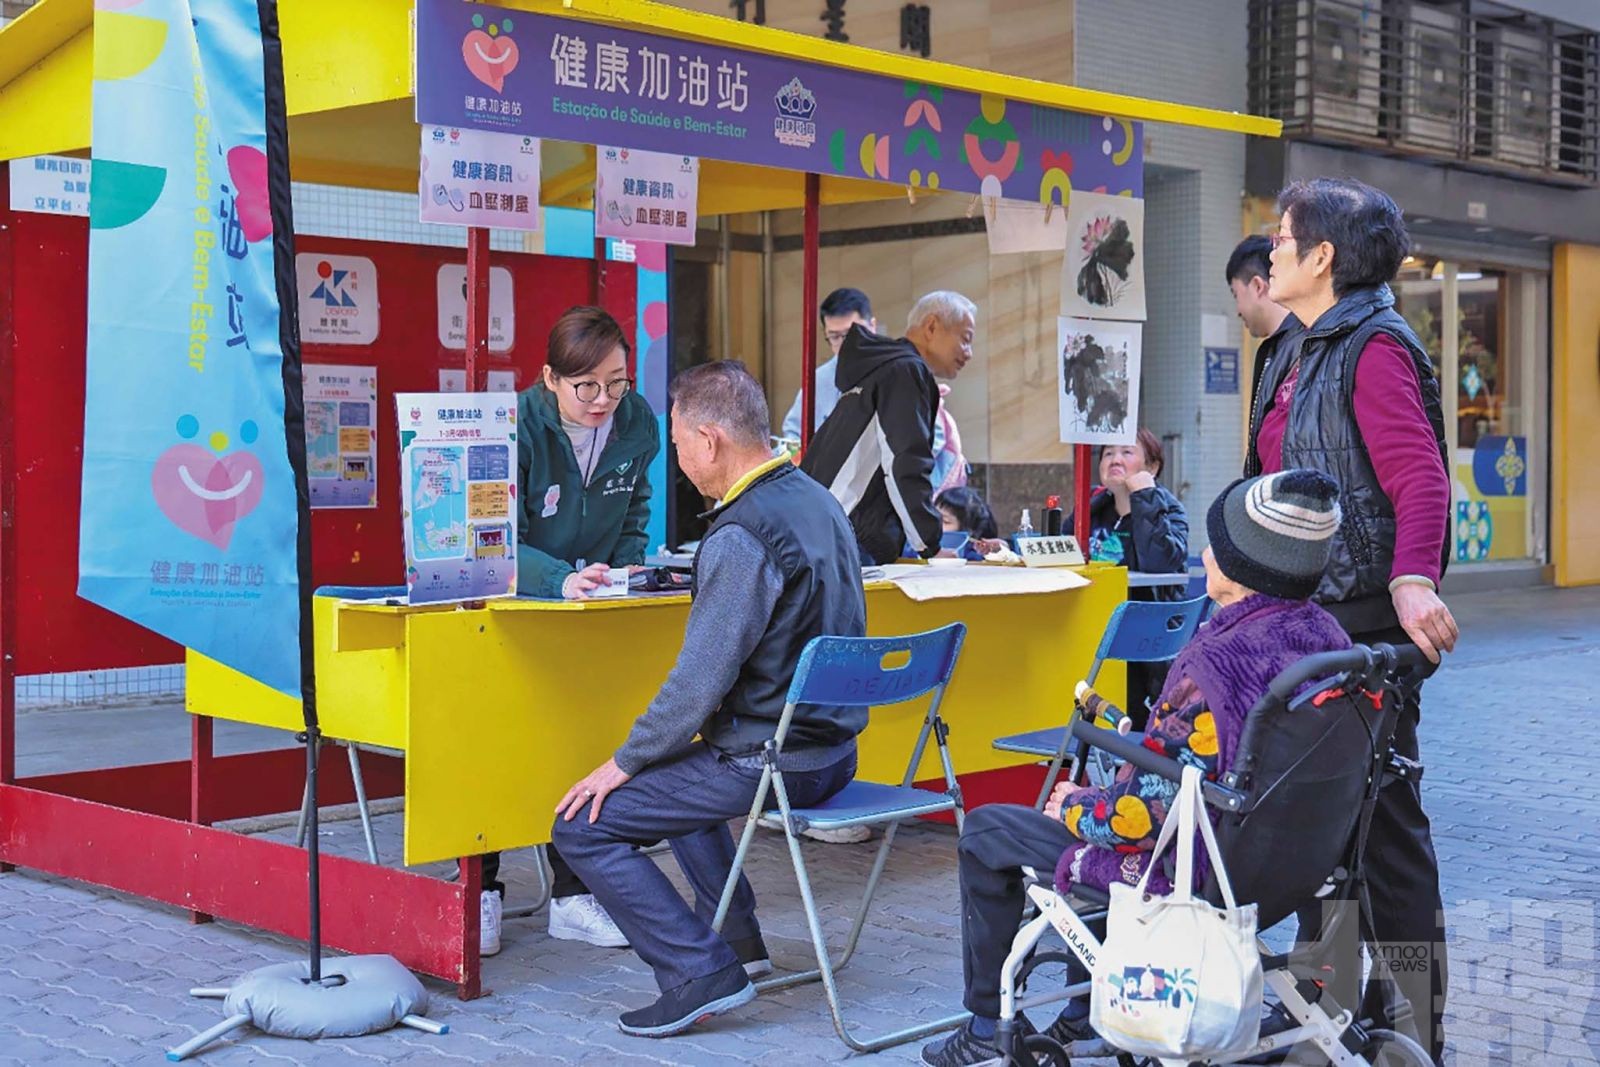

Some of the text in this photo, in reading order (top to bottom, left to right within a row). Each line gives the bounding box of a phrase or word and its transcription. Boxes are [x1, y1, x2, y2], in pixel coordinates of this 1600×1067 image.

[551, 33, 748, 112] 健康加油站
[552, 97, 747, 138] Estação de Saúde e Bem-Estar
[453, 160, 512, 182] 健康資訊
[623, 178, 674, 199] 健康資訊
[469, 192, 529, 213] 血壓測量
[195, 206, 211, 223] e
[636, 208, 687, 227] 血壓測量
[188, 229, 216, 374] Bem-Estar
[437, 408, 483, 420] 健康加油站
[151, 560, 264, 586] 健康加油站
